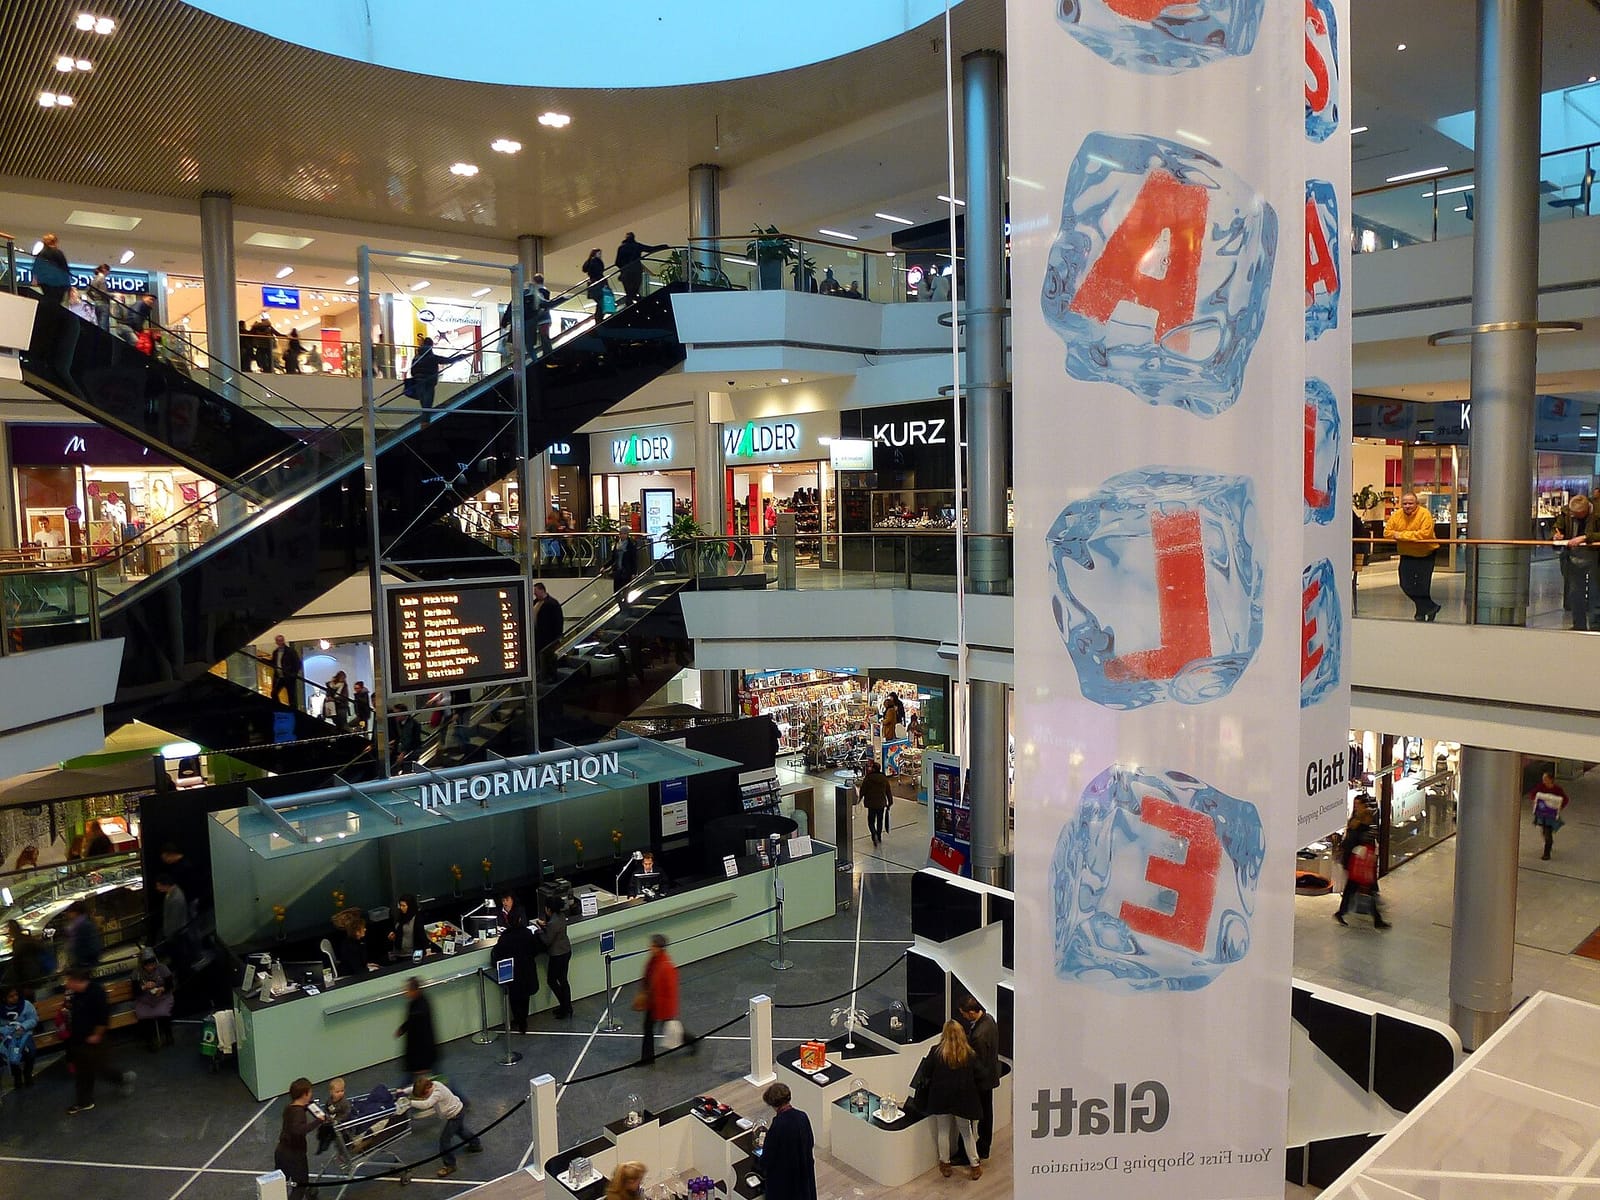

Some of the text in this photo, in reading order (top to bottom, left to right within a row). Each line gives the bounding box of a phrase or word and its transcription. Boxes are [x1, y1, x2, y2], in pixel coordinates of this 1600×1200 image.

[612, 433, 670, 466] WALDER
[725, 421, 796, 457] WALDER
[874, 418, 946, 448] KURZ
[424, 618, 459, 628] Flughafen
[425, 638, 460, 648] Flughafen
[419, 752, 619, 810] INFORMATION
[1305, 751, 1344, 796] Glatt
